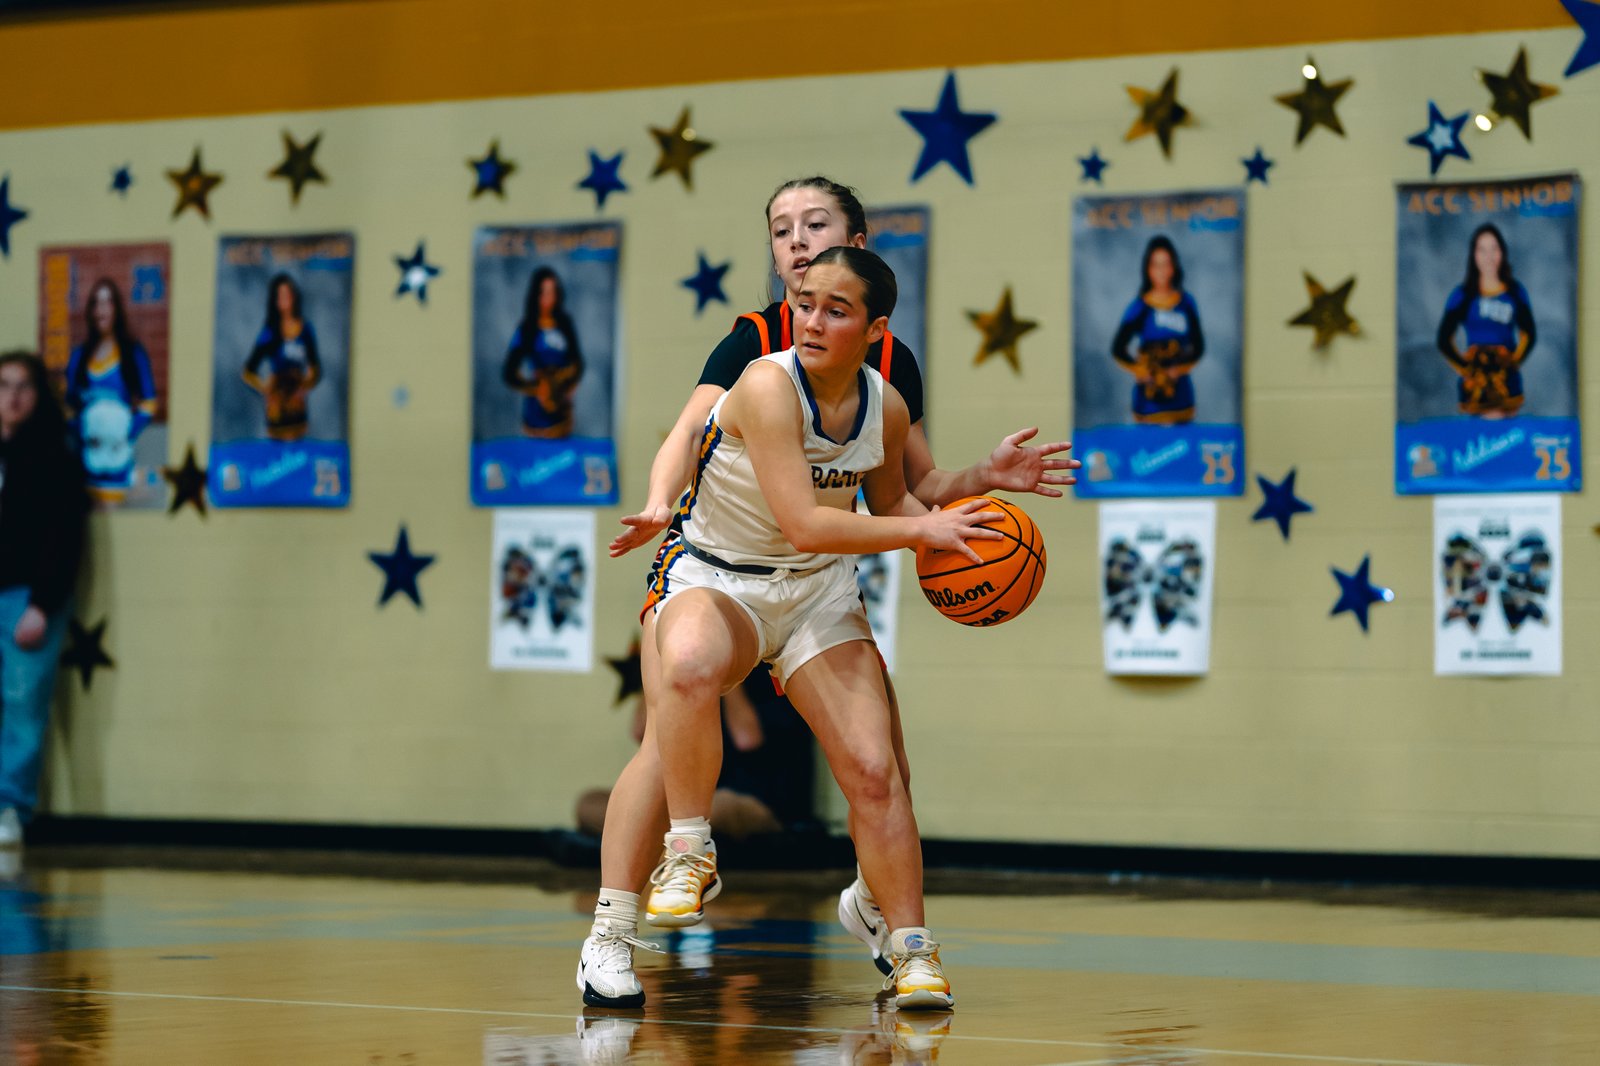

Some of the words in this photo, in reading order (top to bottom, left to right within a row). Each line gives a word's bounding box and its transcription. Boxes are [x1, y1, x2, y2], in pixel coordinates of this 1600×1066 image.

[1467, 181, 1573, 213] SENIOR
[1534, 447, 1572, 481] 25
[922, 580, 996, 608] Wilson
